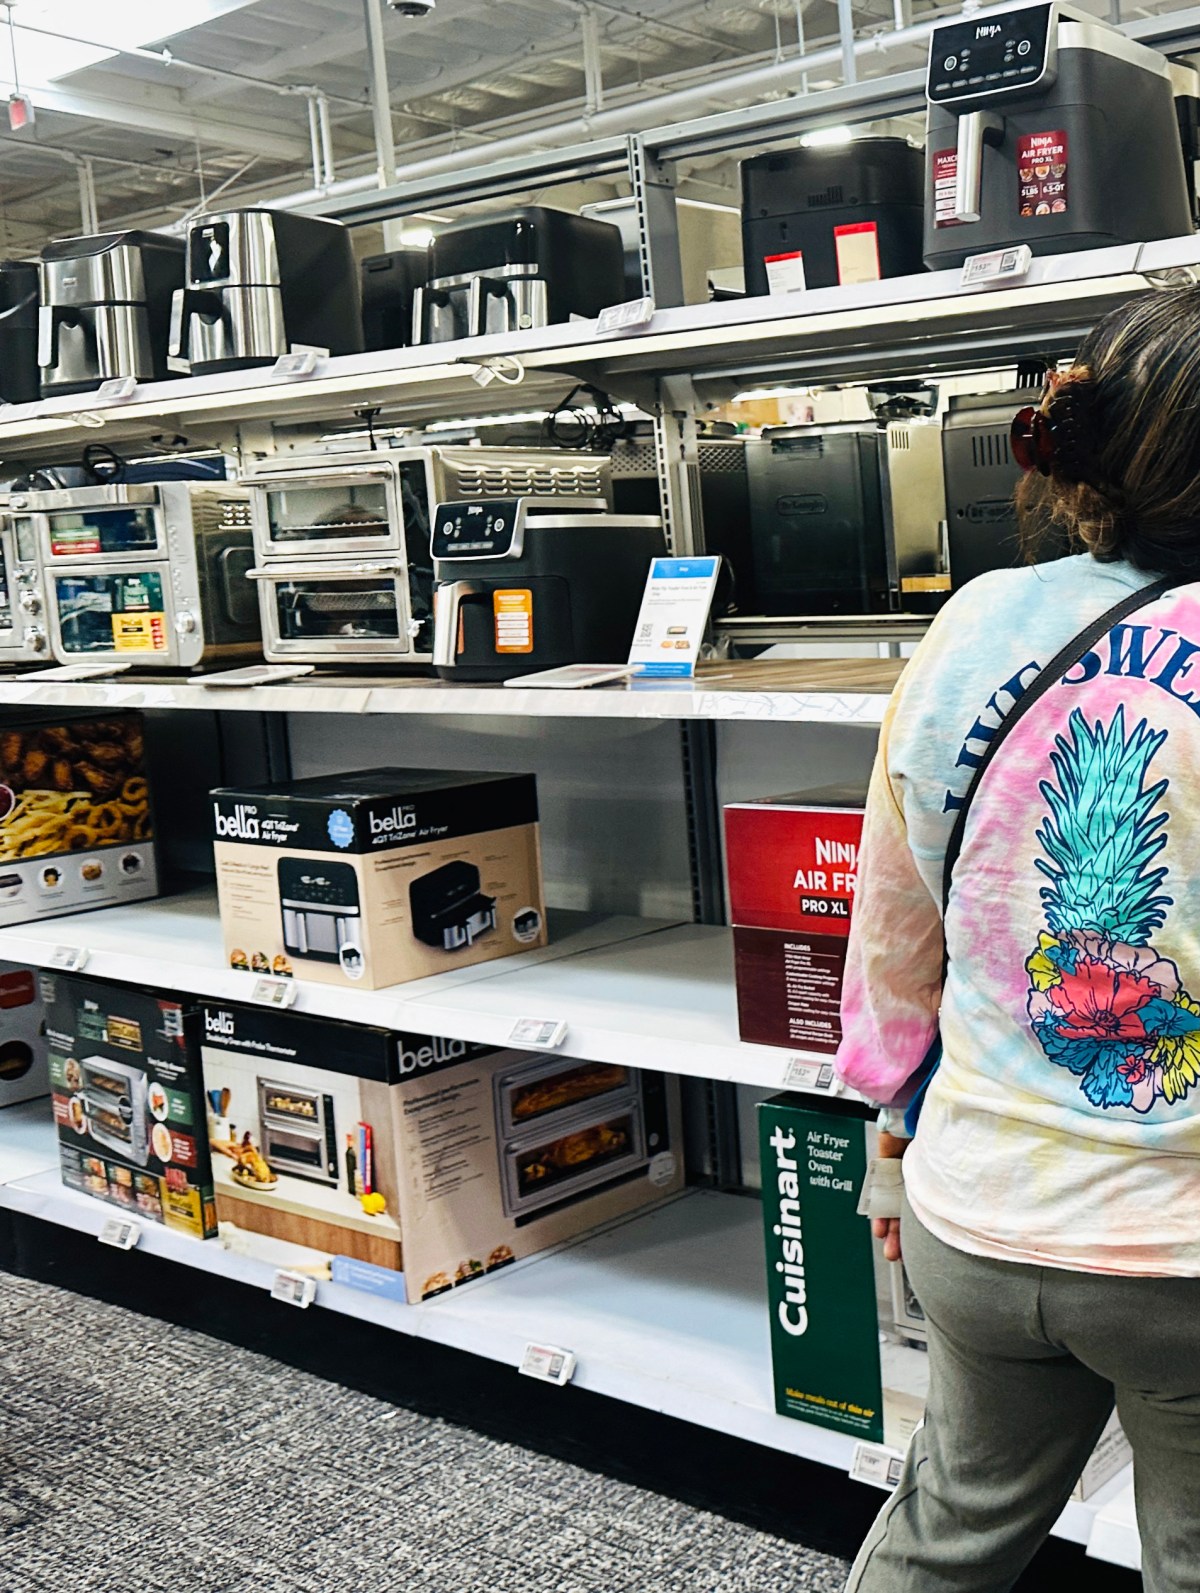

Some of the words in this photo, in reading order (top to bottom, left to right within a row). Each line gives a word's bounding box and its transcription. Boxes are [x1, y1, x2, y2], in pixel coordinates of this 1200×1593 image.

[975, 25, 1001, 39] NINJA
[1021, 148, 1035, 159] AIR
[1037, 145, 1063, 156] FRYER
[1031, 137, 1052, 148] NINJA
[214, 802, 260, 839] bella
[369, 806, 417, 834] bella
[815, 837, 858, 872] NINJ
[793, 869, 828, 891] AIR
[802, 899, 828, 913] PRO
[831, 901, 848, 915] XL
[204, 1008, 235, 1035] bella
[398, 1036, 466, 1075] bella
[807, 1130, 822, 1144] Air
[823, 1133, 850, 1149] Fryer
[807, 1145, 843, 1162] Toaster
[808, 1159, 834, 1175] Oven
[809, 1174, 831, 1188] with
[832, 1178, 853, 1192] Grill
[770, 1126, 809, 1337] Cuisinart
